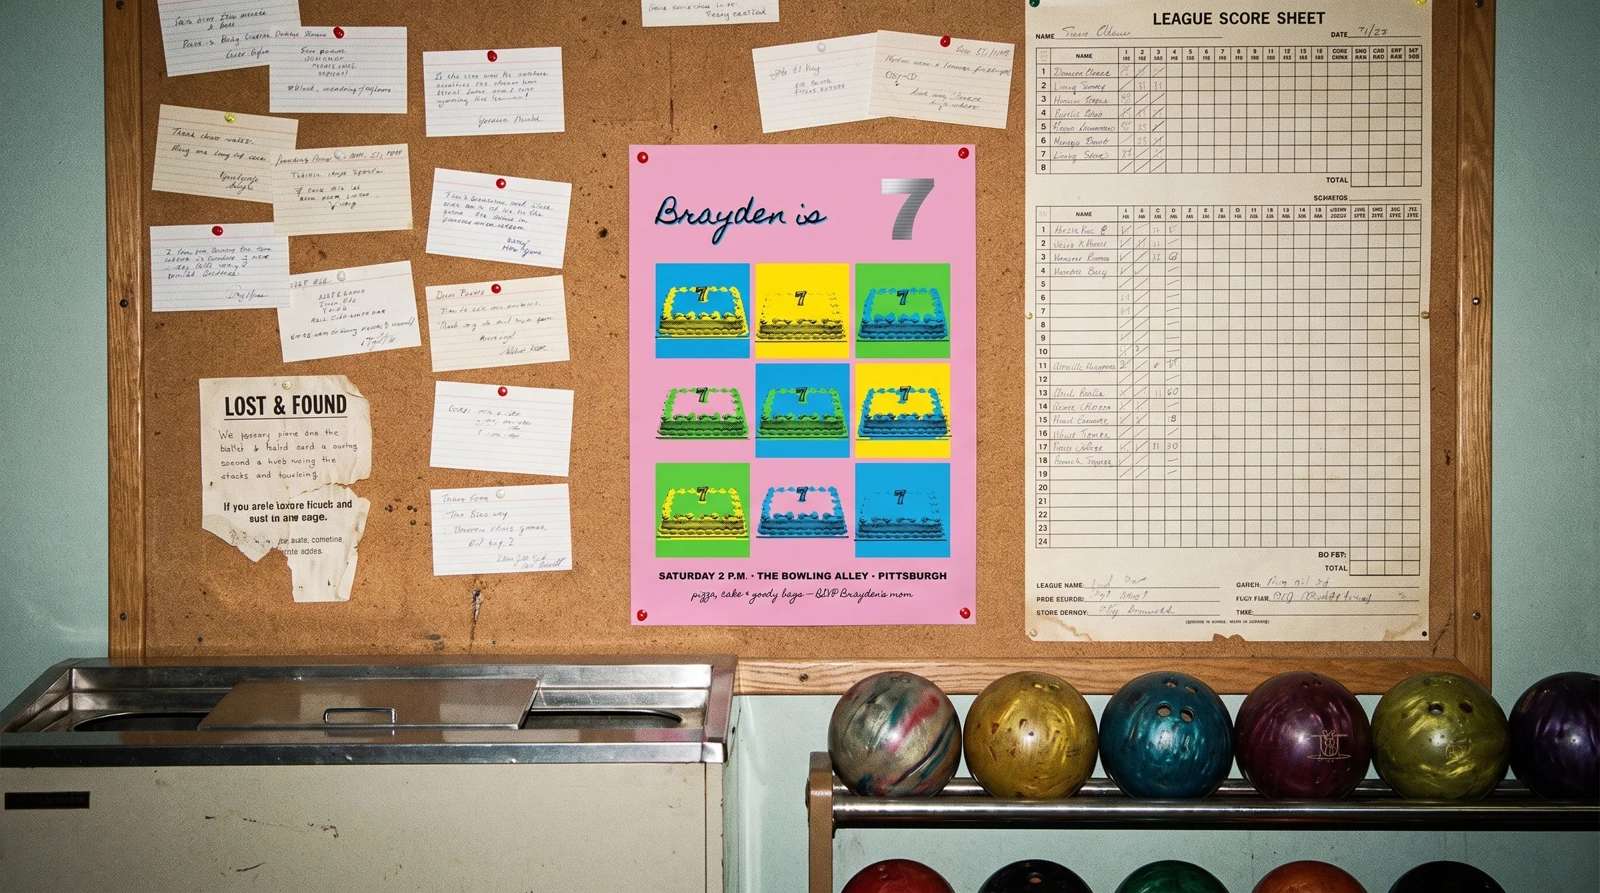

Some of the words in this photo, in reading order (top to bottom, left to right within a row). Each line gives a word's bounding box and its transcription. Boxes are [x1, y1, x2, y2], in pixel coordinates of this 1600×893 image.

[1154, 13, 1212, 25] LEAGUE
[1220, 12, 1270, 24] SCORE
[1277, 12, 1325, 24] SHEET
[881, 178, 935, 240] 7
[654, 196, 787, 245] Brayden
[796, 203, 828, 225] is
[696, 286, 708, 302] 7
[794, 290, 808, 306] 7
[896, 289, 910, 305] 7
[696, 386, 708, 403] 7
[795, 386, 808, 402] 7
[899, 385, 911, 401] 7
[225, 396, 266, 416] LOST
[274, 396, 285, 415] &
[293, 395, 346, 414] FOUND
[218, 430, 234, 440] We
[324, 428, 339, 437] the
[321, 455, 337, 464] the
[256, 471, 271, 479] and
[696, 486, 709, 502] 7
[796, 486, 809, 502] 7
[893, 489, 906, 505] 7
[224, 502, 230, 511] If
[233, 504, 248, 512] you
[337, 500, 352, 508] and
[659, 572, 715, 580] SATURDAY
[782, 572, 831, 580] BOWLING
[879, 572, 946, 580] PITTSBURGH
[691, 589, 718, 603] pizza,
[720, 589, 744, 598] cake
[749, 588, 778, 604] goody
[781, 588, 804, 604] bags
[840, 588, 888, 604] Brayden's
